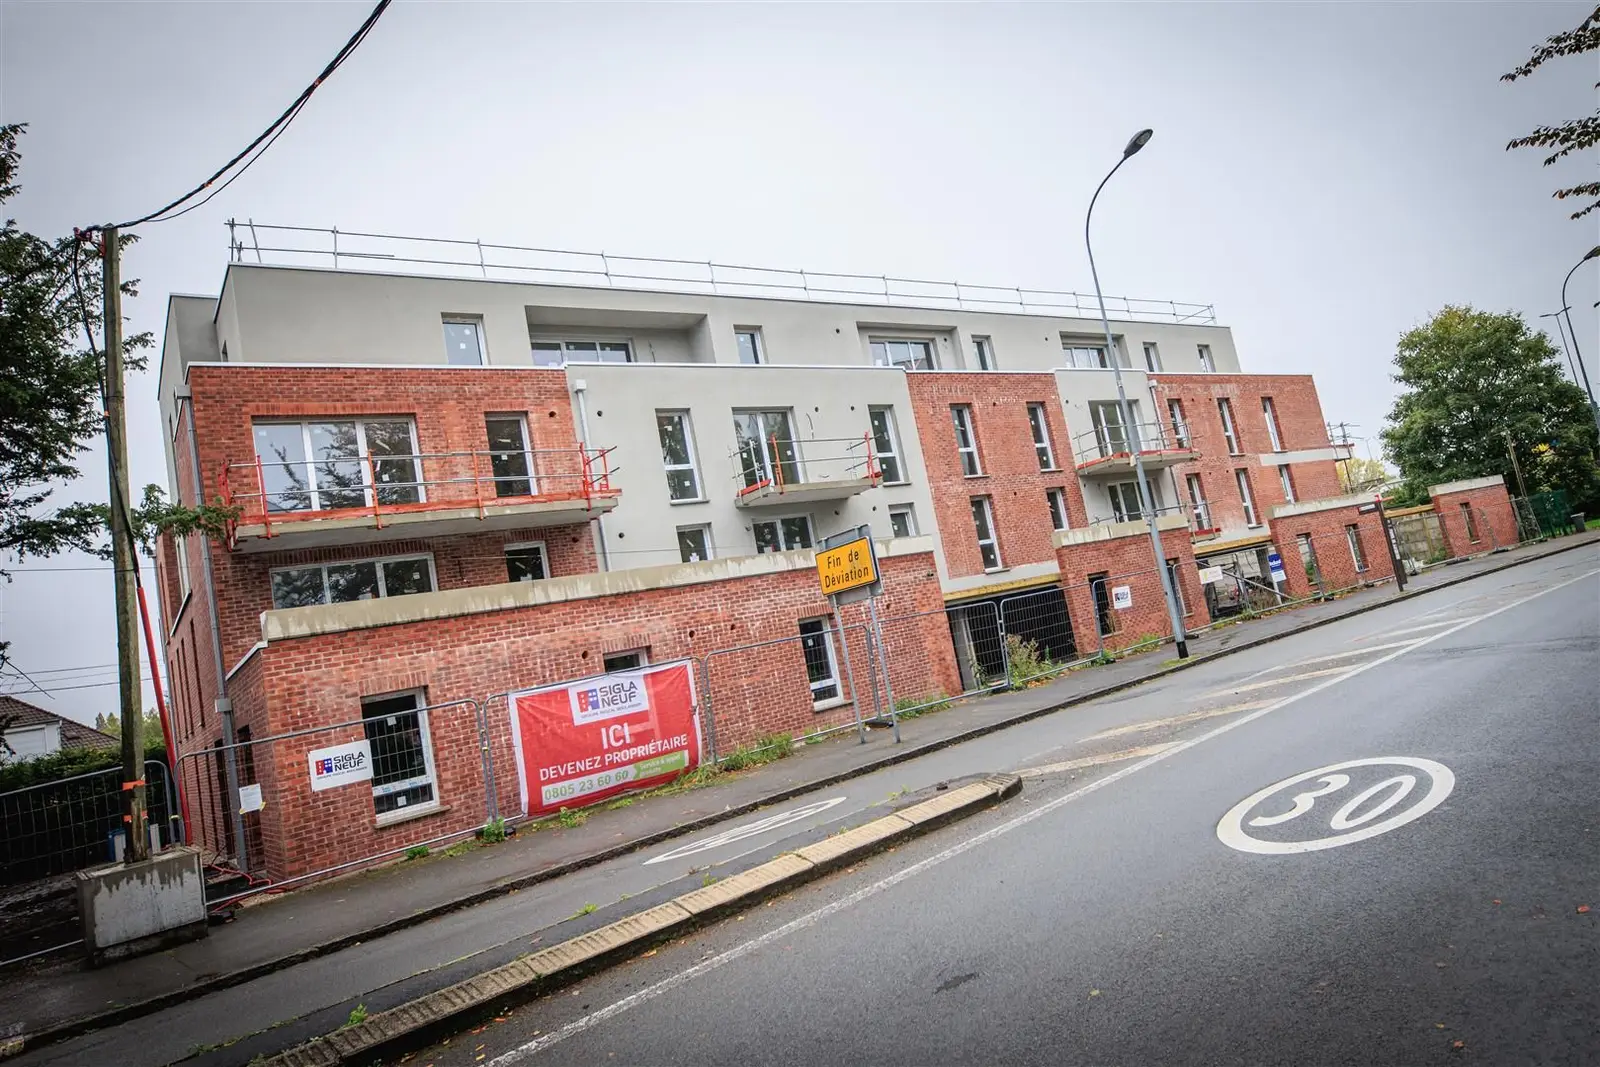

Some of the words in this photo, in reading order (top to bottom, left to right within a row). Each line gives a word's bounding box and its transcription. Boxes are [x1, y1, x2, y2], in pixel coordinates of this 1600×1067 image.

[827, 555, 841, 569] Fin
[848, 549, 859, 563] de
[824, 566, 869, 588] Déviation
[599, 681, 638, 697] SIGLA
[601, 692, 637, 708] NEUF
[601, 722, 631, 749] ICI
[333, 751, 365, 764] SIGLA
[334, 759, 364, 772] NEUF
[540, 756, 602, 781] DEVENEZ
[604, 734, 688, 765] PROPRIÉTAIRE
[544, 784, 575, 800] 0805
[578, 779, 594, 792] 23
[597, 774, 611, 786] 60
[615, 770, 629, 781] 60
[1248, 774, 1417, 830] 30
